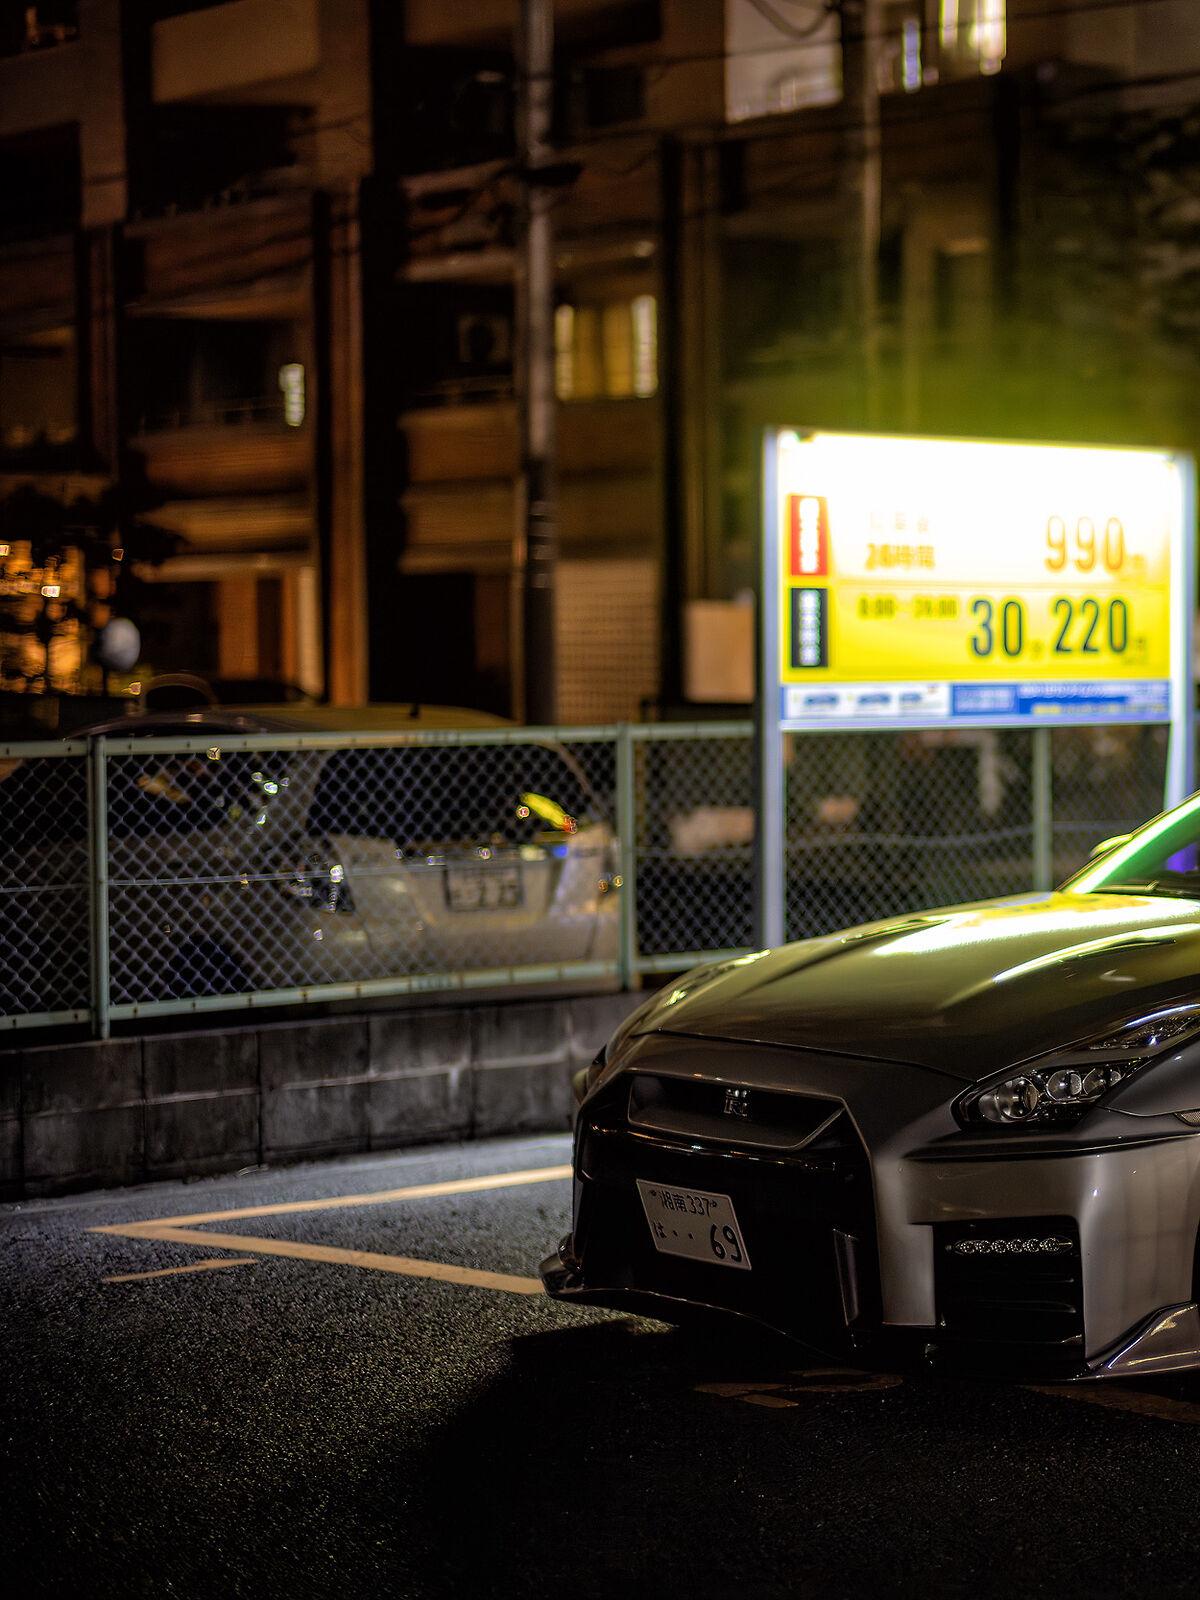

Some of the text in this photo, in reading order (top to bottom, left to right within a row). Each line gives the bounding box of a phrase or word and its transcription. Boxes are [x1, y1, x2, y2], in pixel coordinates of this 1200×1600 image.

[1045, 515, 1125, 570] 990
[971, 600, 1023, 656] 30
[1053, 599, 1128, 653] 220
[710, 1224, 743, 1262] 69
